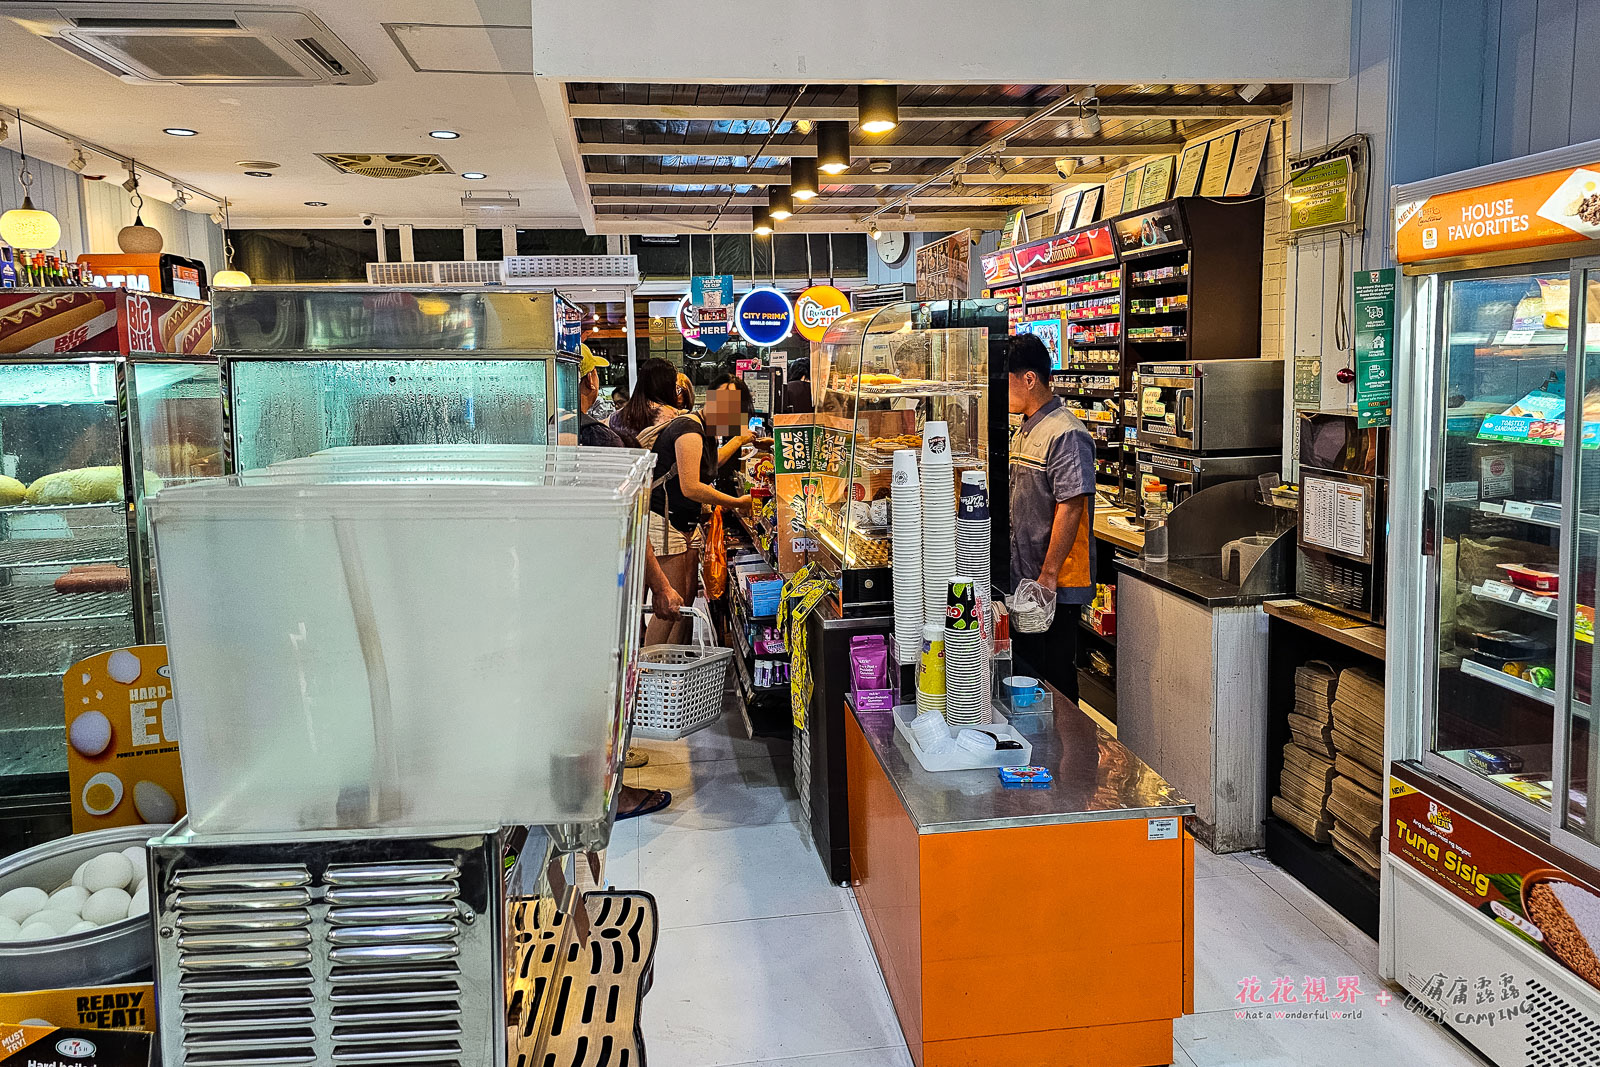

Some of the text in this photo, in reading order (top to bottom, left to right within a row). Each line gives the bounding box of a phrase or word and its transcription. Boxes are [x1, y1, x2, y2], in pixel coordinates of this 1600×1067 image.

[1397, 201, 1417, 225] NEW!
[1462, 199, 1514, 222] HOUSE
[1448, 215, 1529, 241] FAVORITES
[93, 274, 150, 292] ATM
[762, 312, 786, 320] PRIMA
[700, 326, 727, 335] HERE
[780, 431, 795, 470] SAVE
[793, 431, 805, 459] 30%
[1391, 785, 1406, 795] NEW!
[1396, 819, 1490, 897] Tuna Sisig
[76, 991, 145, 1012] READY
[78, 1008, 146, 1029] TO EAT!
[1, 1029, 24, 1047] MUST
[6, 1039, 27, 1054] TRY!
